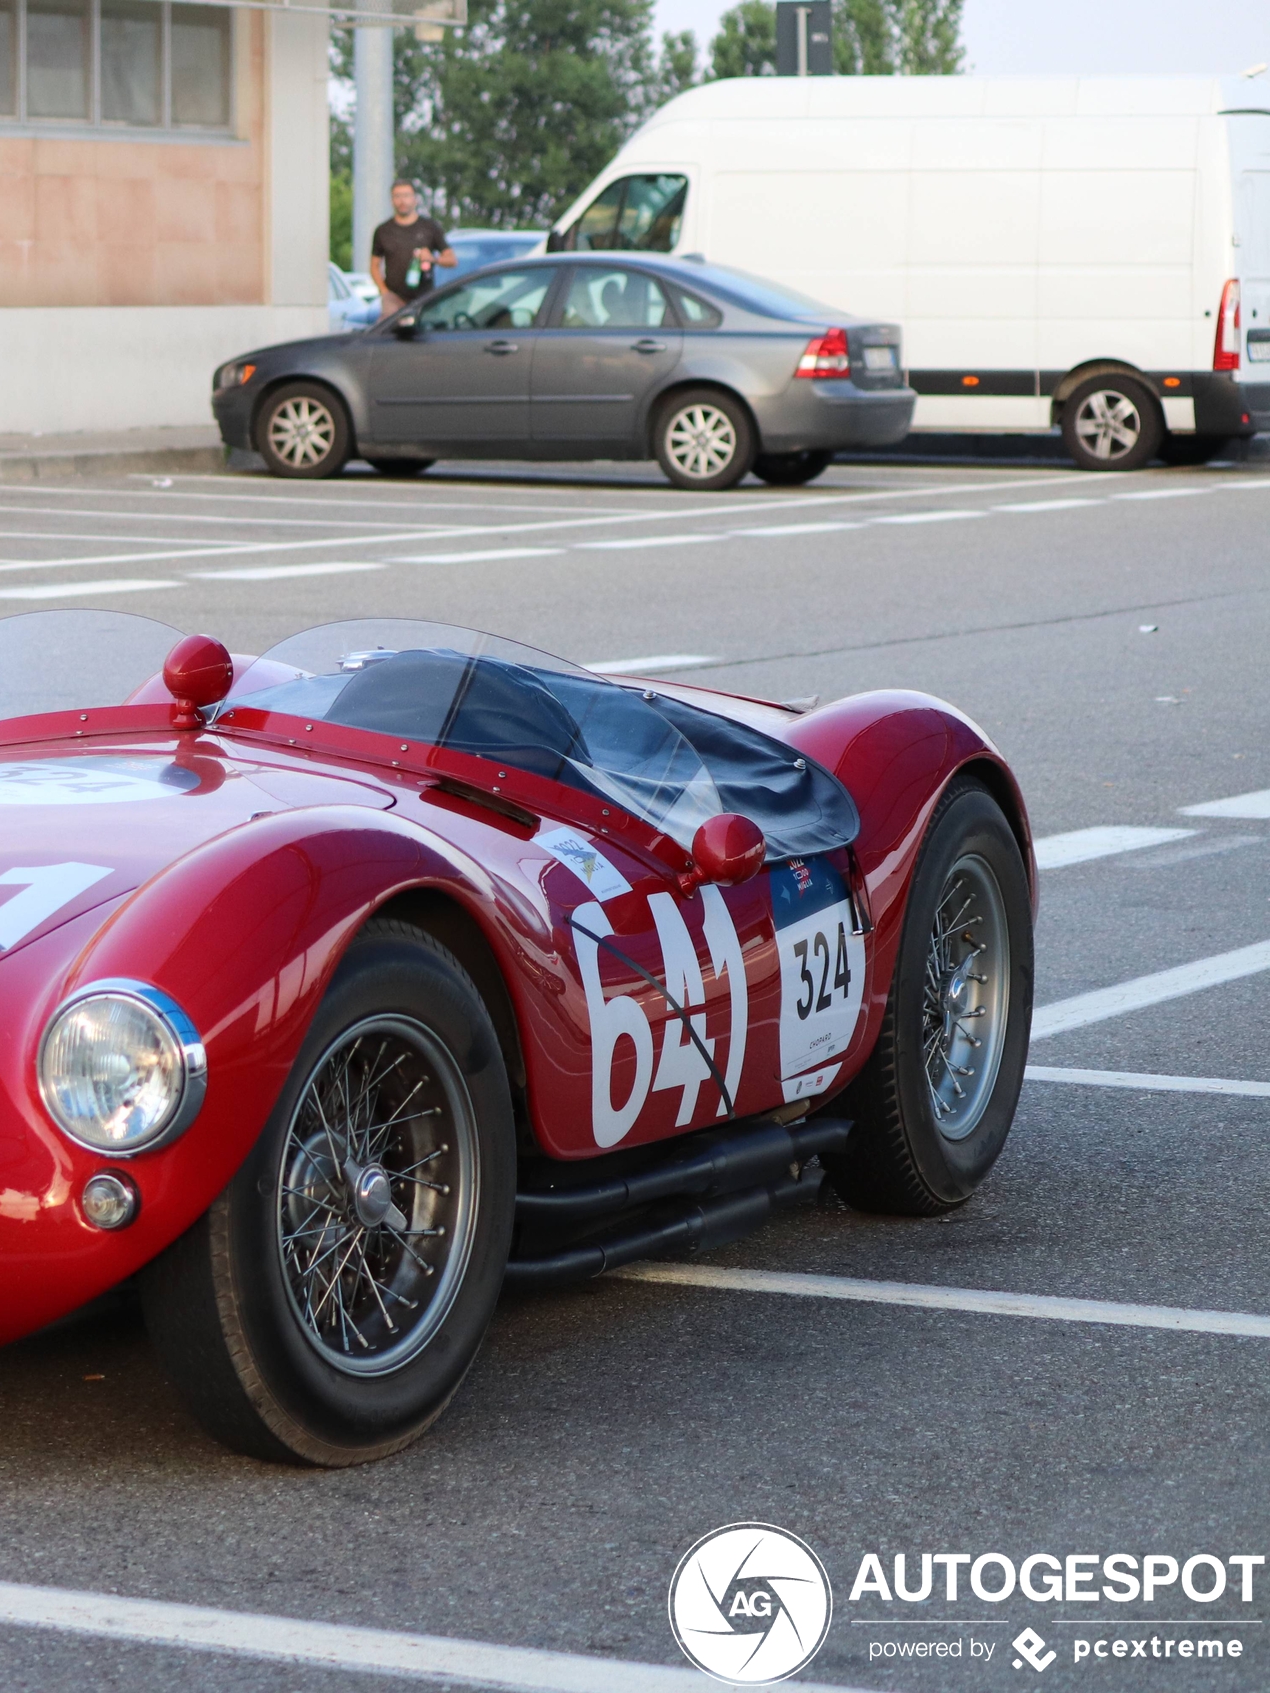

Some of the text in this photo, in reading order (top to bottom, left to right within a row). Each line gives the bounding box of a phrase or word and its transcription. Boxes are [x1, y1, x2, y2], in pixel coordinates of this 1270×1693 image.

[580, 861, 605, 874] MIGLIA
[571, 884, 748, 1148] 641
[794, 922, 851, 1020] 324
